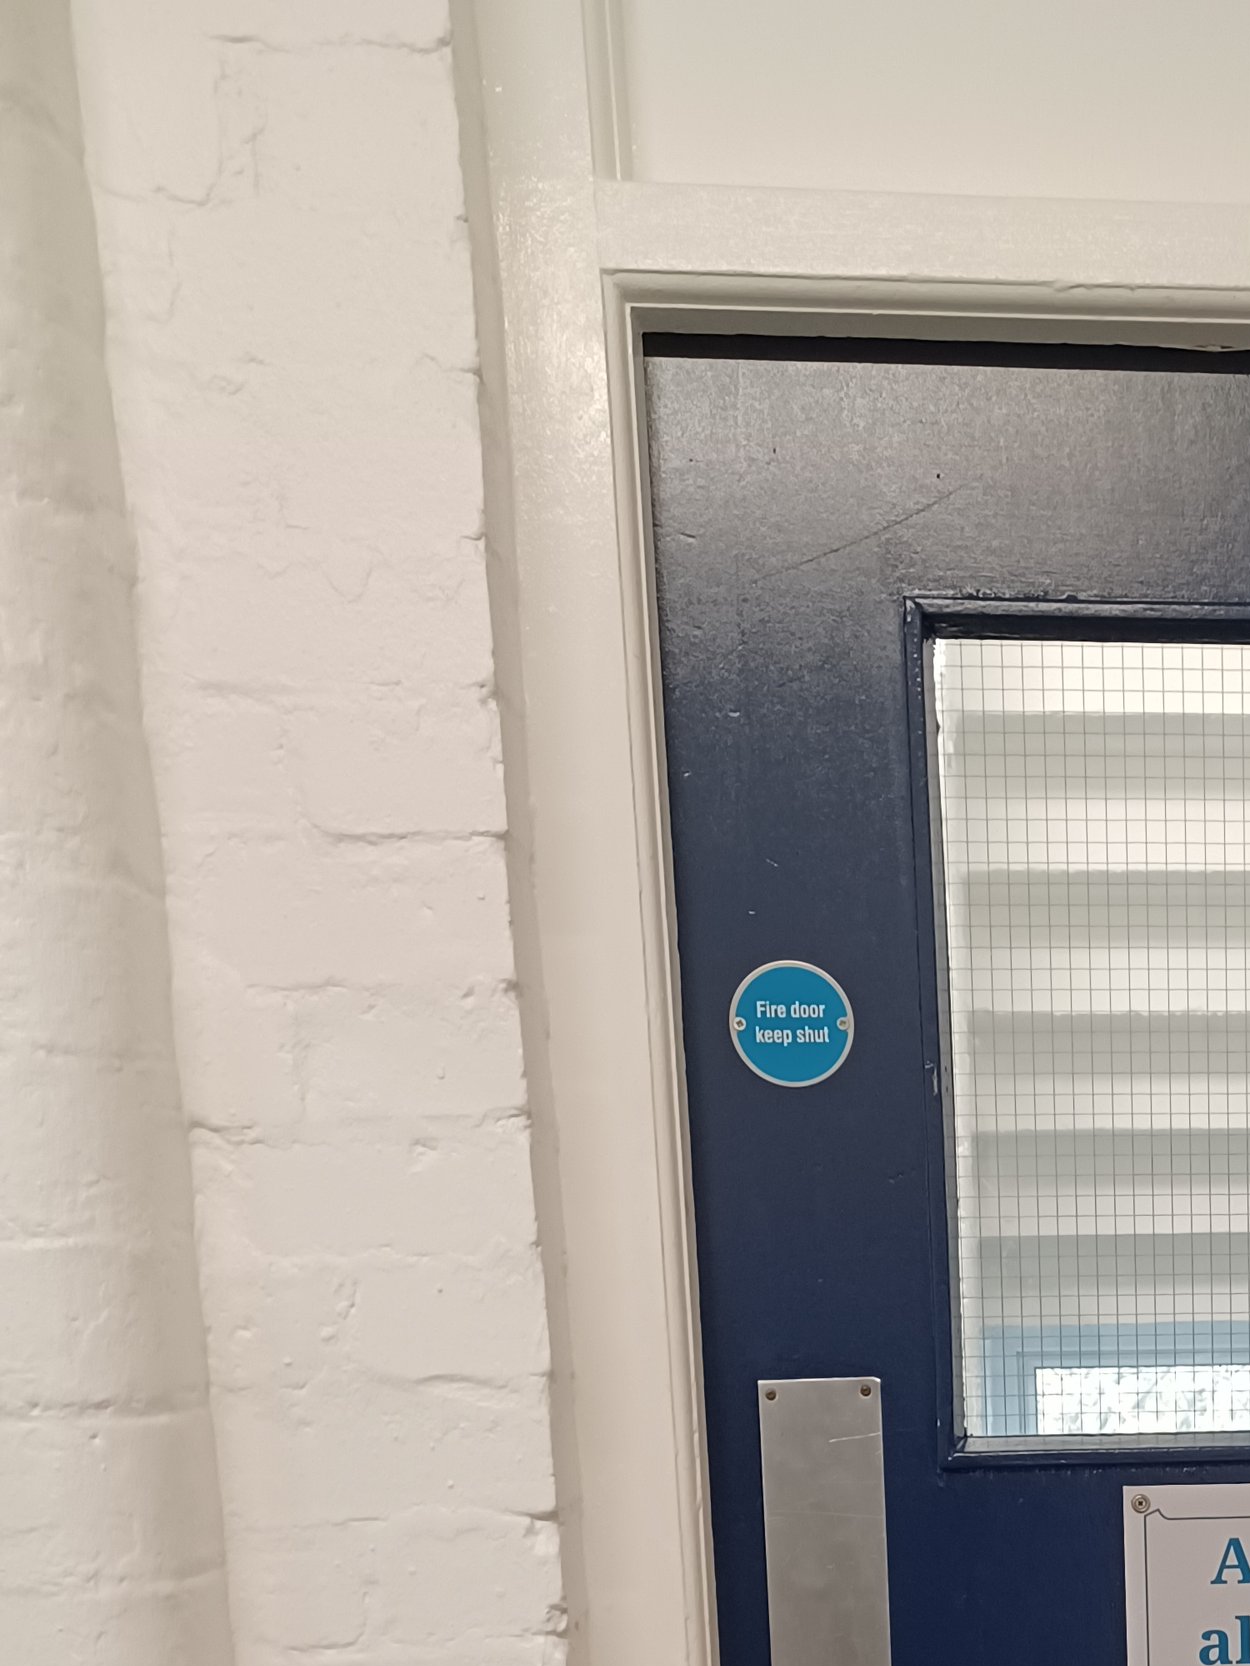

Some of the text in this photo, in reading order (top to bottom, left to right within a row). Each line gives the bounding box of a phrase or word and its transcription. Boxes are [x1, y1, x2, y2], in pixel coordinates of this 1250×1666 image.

[756, 1000, 825, 1018] Fire door
[755, 1026, 830, 1047] keep shut
